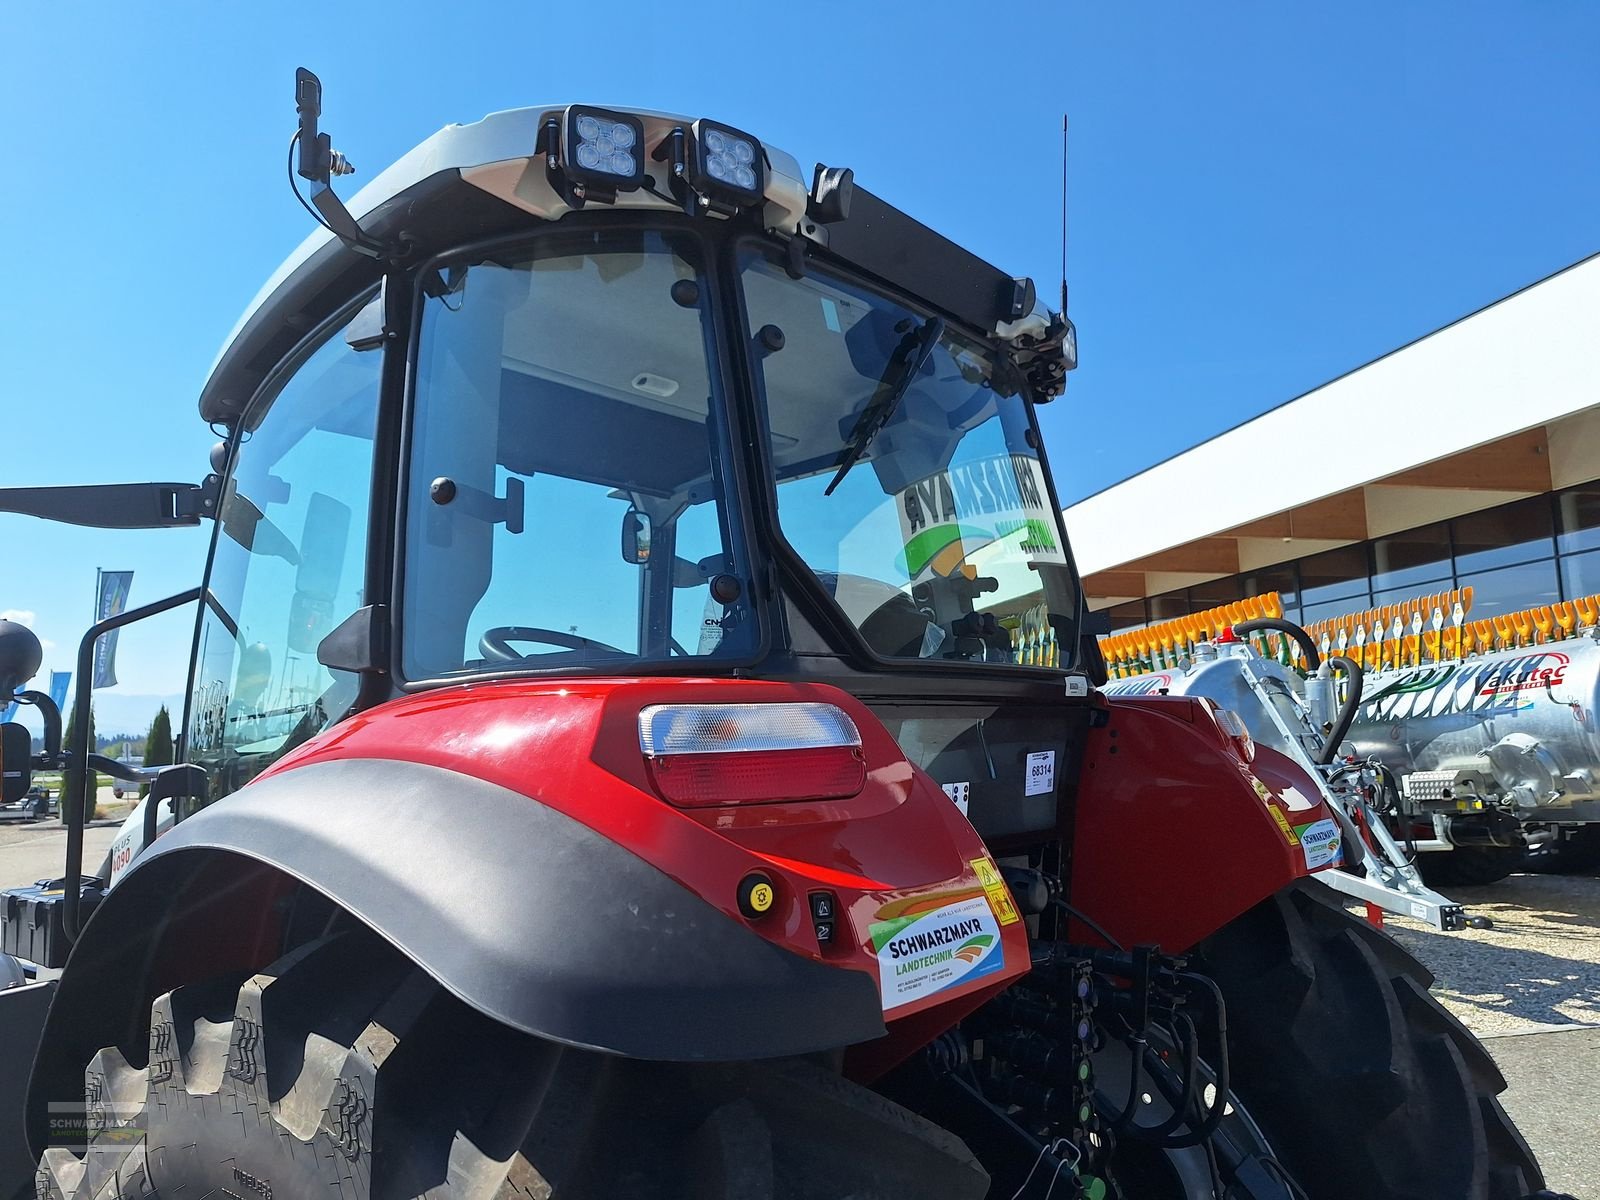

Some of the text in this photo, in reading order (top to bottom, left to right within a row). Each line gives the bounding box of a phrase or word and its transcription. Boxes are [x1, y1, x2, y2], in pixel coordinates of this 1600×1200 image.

[1031, 763, 1052, 777] 68314
[888, 918, 983, 959] SCHWARZMAYR
[895, 949, 953, 976] LANDTECHNIK
